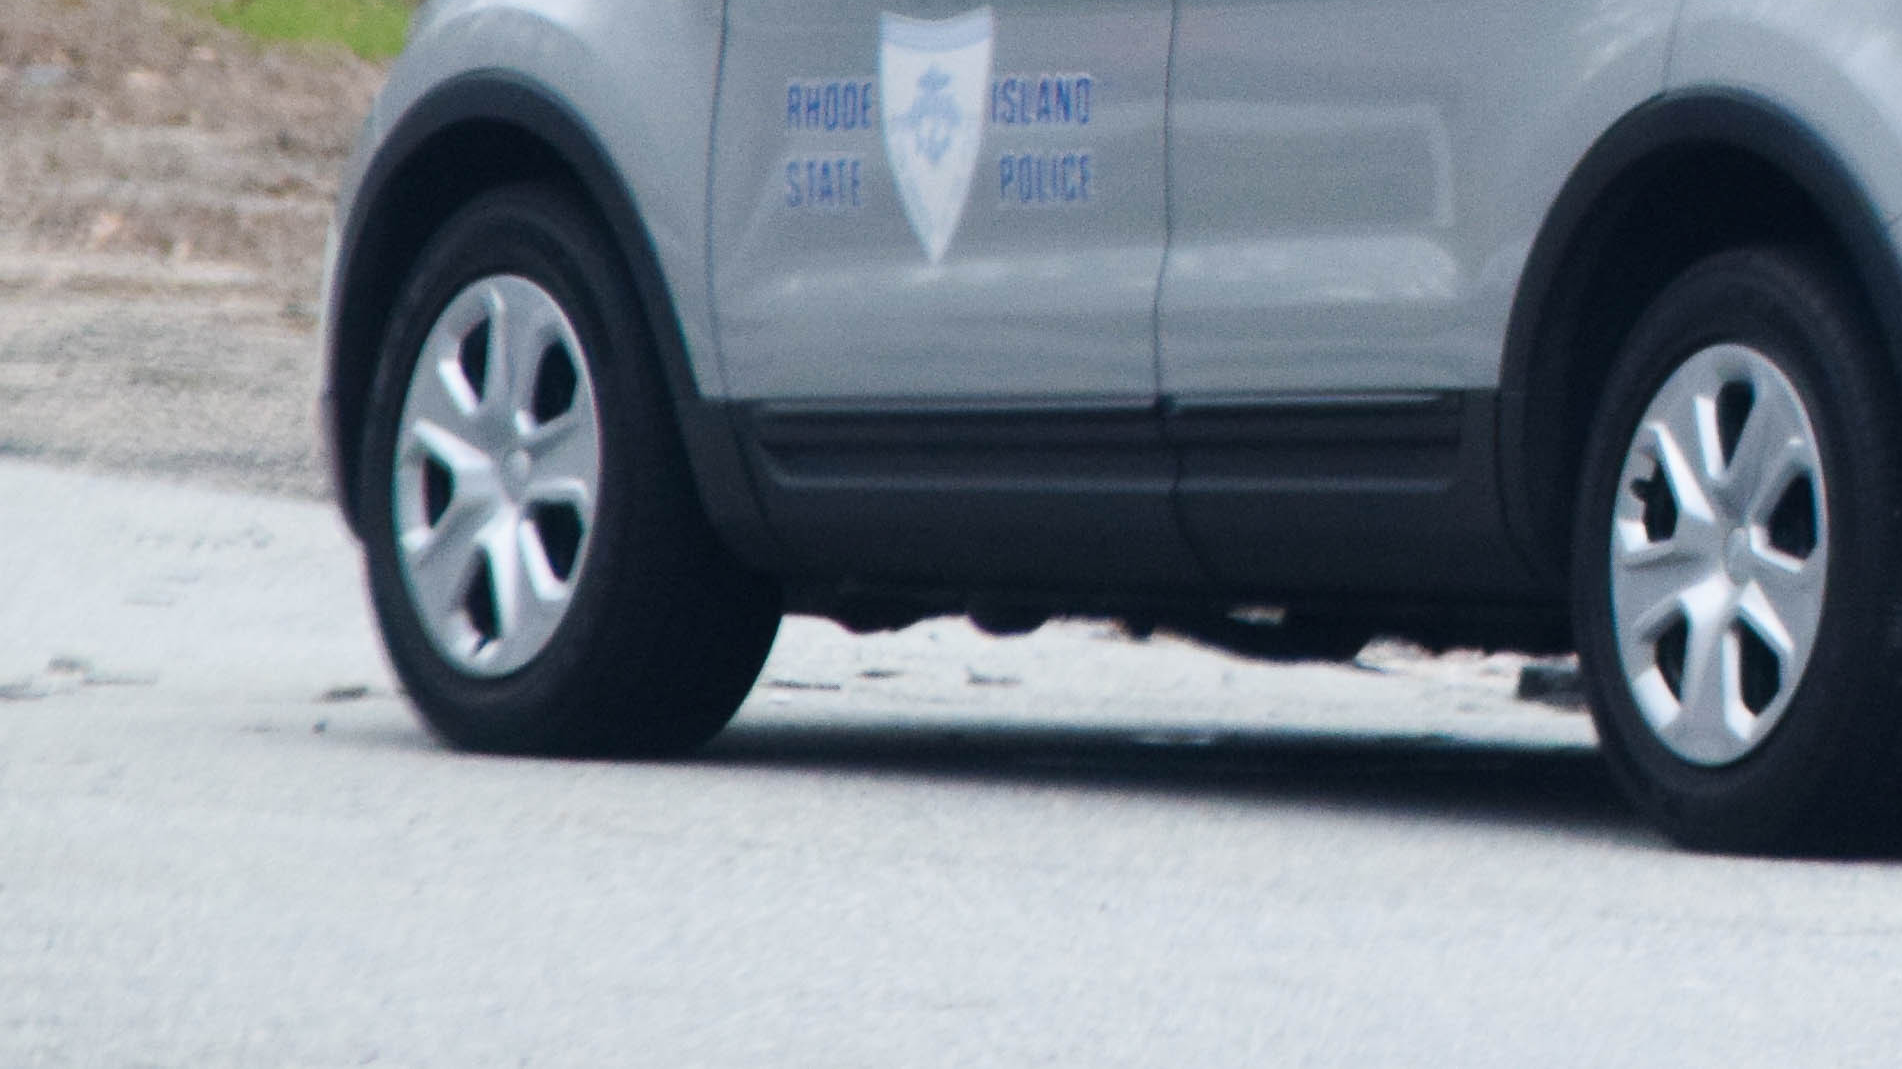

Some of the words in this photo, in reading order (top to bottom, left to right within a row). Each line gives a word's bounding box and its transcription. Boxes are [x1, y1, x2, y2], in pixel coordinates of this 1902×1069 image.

[787, 81, 873, 130] RHODE
[991, 76, 1091, 126] ISLAND
[785, 158, 861, 208] STATE
[1000, 153, 1092, 203] POLICE
